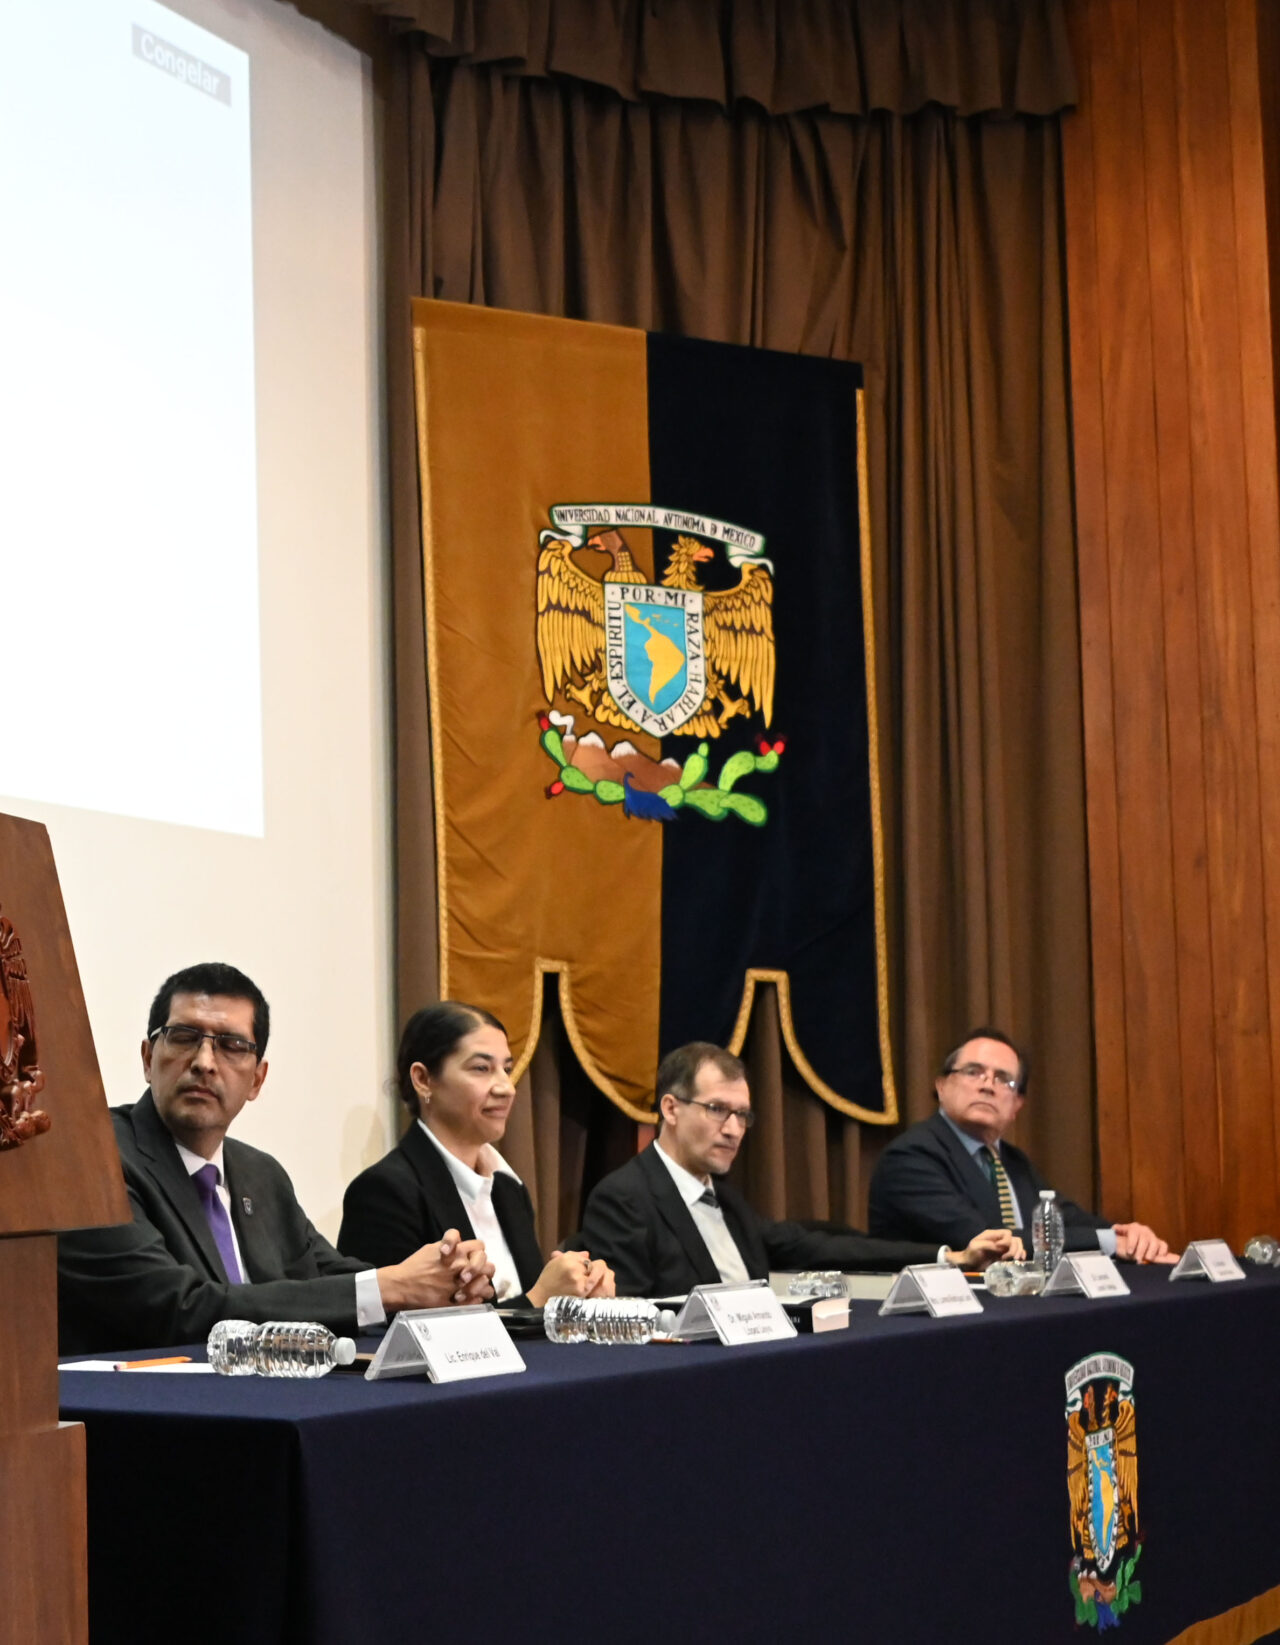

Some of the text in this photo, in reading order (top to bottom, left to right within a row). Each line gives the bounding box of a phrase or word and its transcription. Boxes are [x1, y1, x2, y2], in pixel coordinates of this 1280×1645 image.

[141, 34, 220, 95] Congelar
[615, 508, 658, 524] NACIONAL
[722, 526, 756, 549] MEXICO
[620, 586, 656, 603] POR
[665, 591, 687, 607] MI
[607, 600, 623, 681] ESPIRITU
[687, 612, 701, 661] RAZA
[617, 687, 637, 711] EL
[457, 1351, 481, 1366] Enrique
[481, 1348, 490, 1360] del
[491, 1347, 501, 1359] Val
